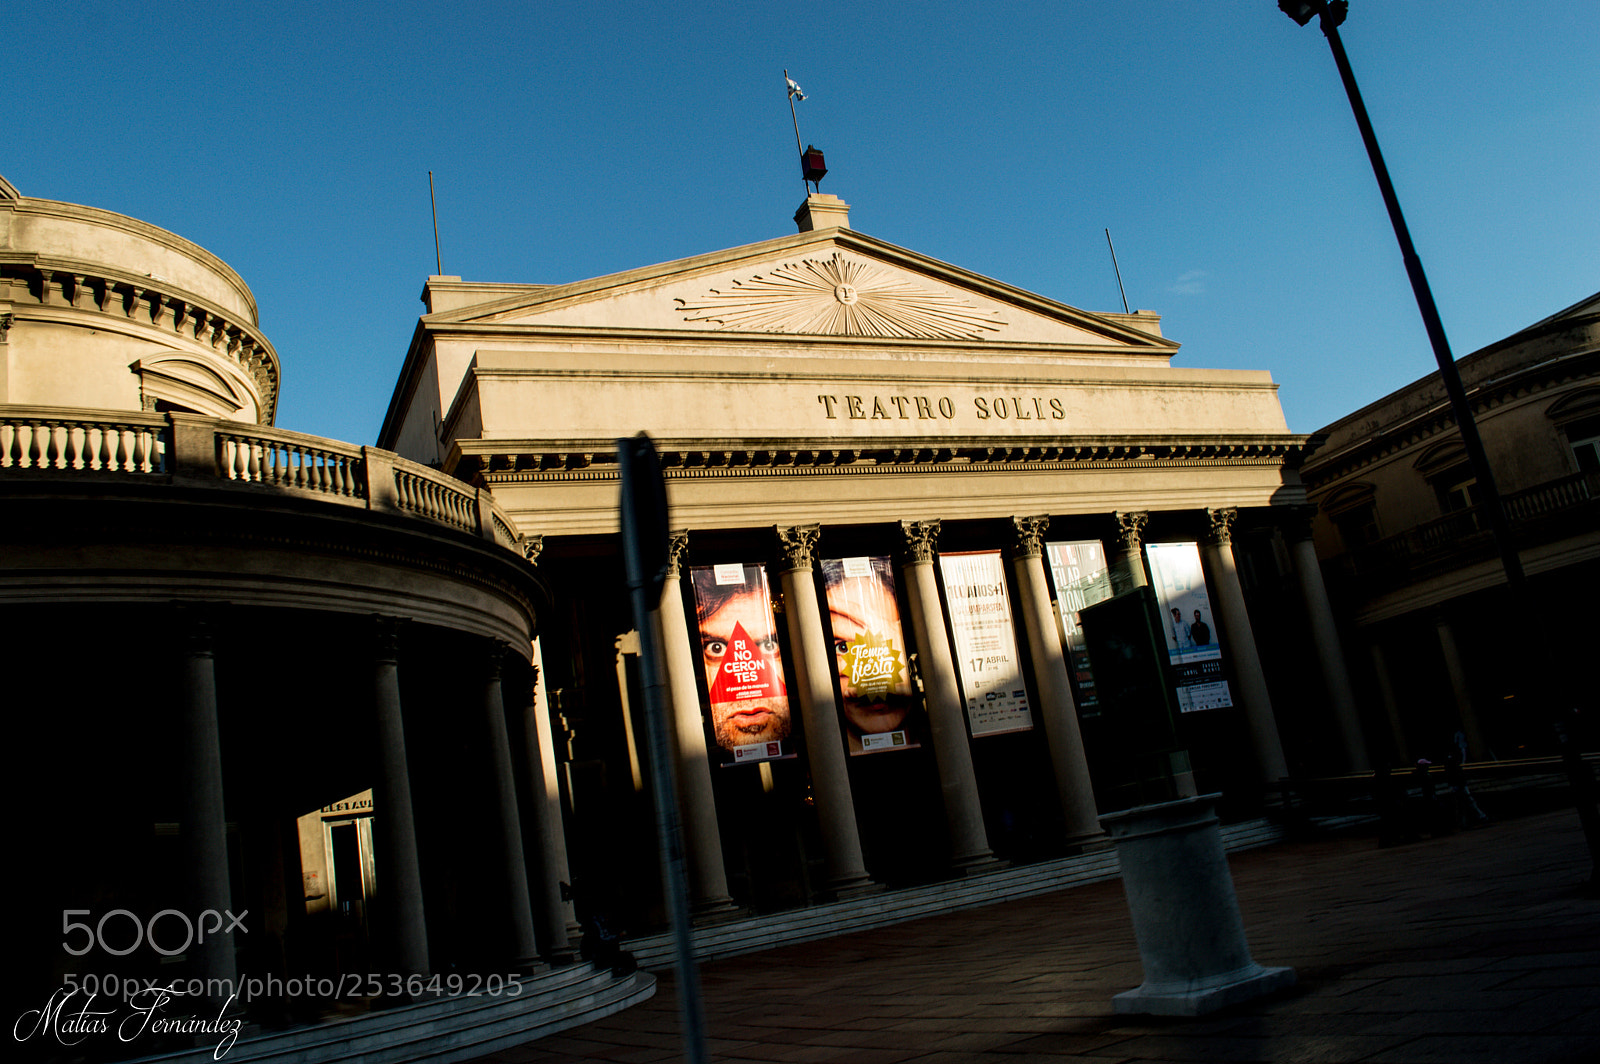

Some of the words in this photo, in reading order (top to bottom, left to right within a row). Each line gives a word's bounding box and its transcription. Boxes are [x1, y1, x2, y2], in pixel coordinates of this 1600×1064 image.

[818, 395, 955, 420] TEATRO
[974, 396, 1066, 420] SOLIS
[734, 640, 746, 650] RI
[850, 643, 890, 661] Tiempo
[733, 650, 752, 662] NO
[724, 660, 765, 673] CERON
[851, 656, 894, 684] fiesta
[969, 657, 984, 673] 17
[986, 655, 1009, 664] ABRIL
[735, 671, 758, 682] TES
